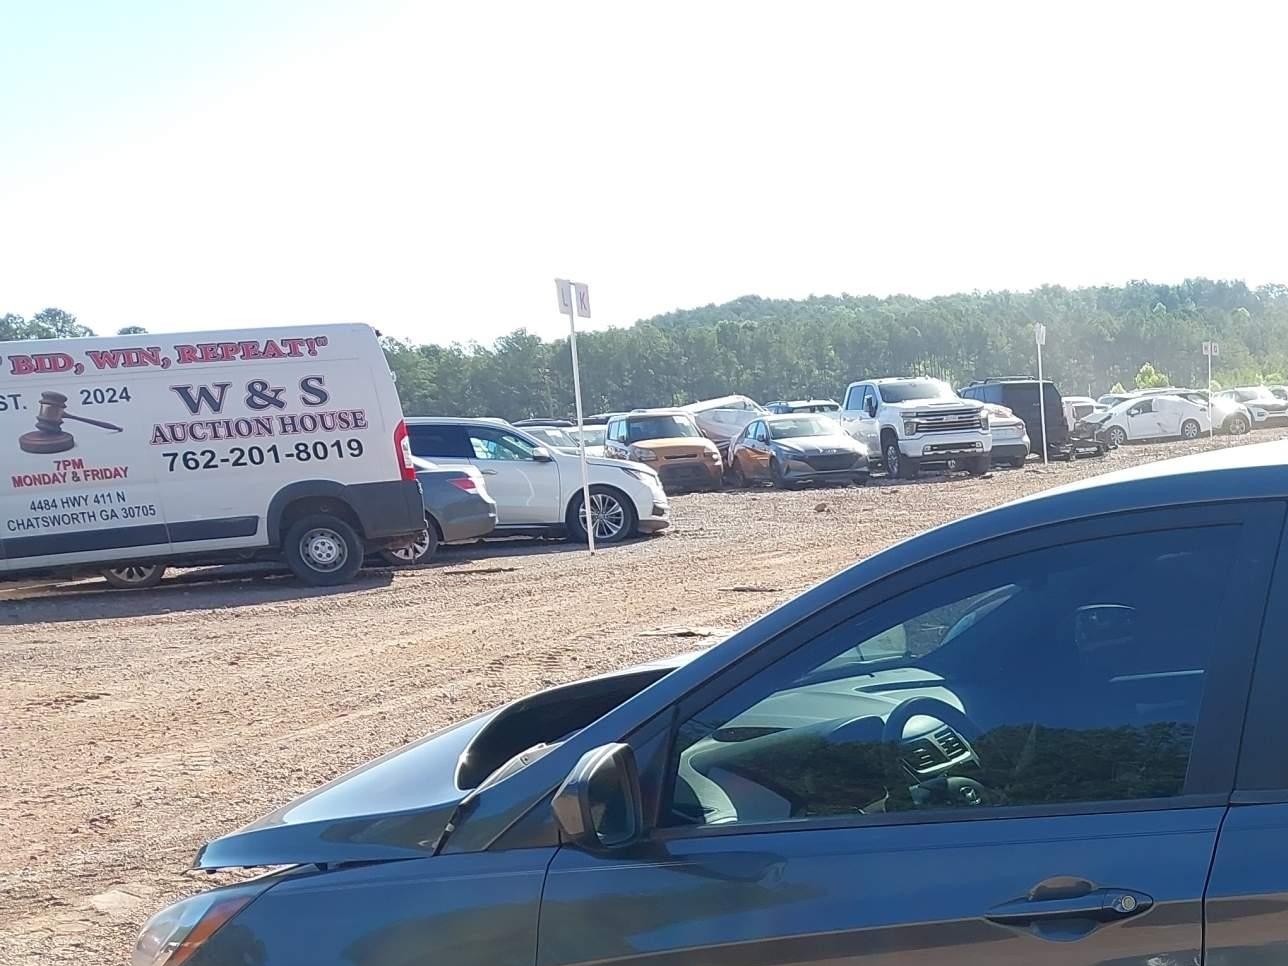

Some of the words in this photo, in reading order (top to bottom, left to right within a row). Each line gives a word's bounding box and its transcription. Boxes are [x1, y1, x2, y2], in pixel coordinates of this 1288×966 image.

[561, 288, 569, 307] L
[579, 291, 588, 311] K
[85, 346, 171, 369] WIN,
[174, 336, 328, 364] REPEAT!"
[79, 387, 131, 405] 2024
[170, 381, 233, 415] W
[245, 378, 286, 411] &
[299, 374, 330, 408] S
[150, 415, 275, 445] AUCTION
[278, 409, 368, 435] HOUSE
[53, 459, 85, 472] 7PM
[162, 438, 364, 472] 762-201-8019
[11, 472, 67, 488] MONDAY
[71, 471, 81, 483] &
[84, 466, 129, 481] FRIDAY
[30, 500, 58, 512] 4484
[61, 495, 89, 509] HWY
[93, 492, 111, 505] 411
[116, 491, 126, 502] N
[7, 511, 97, 532] CHATSWORTH
[100, 509, 119, 521] GA
[122, 504, 156, 518] 30705
